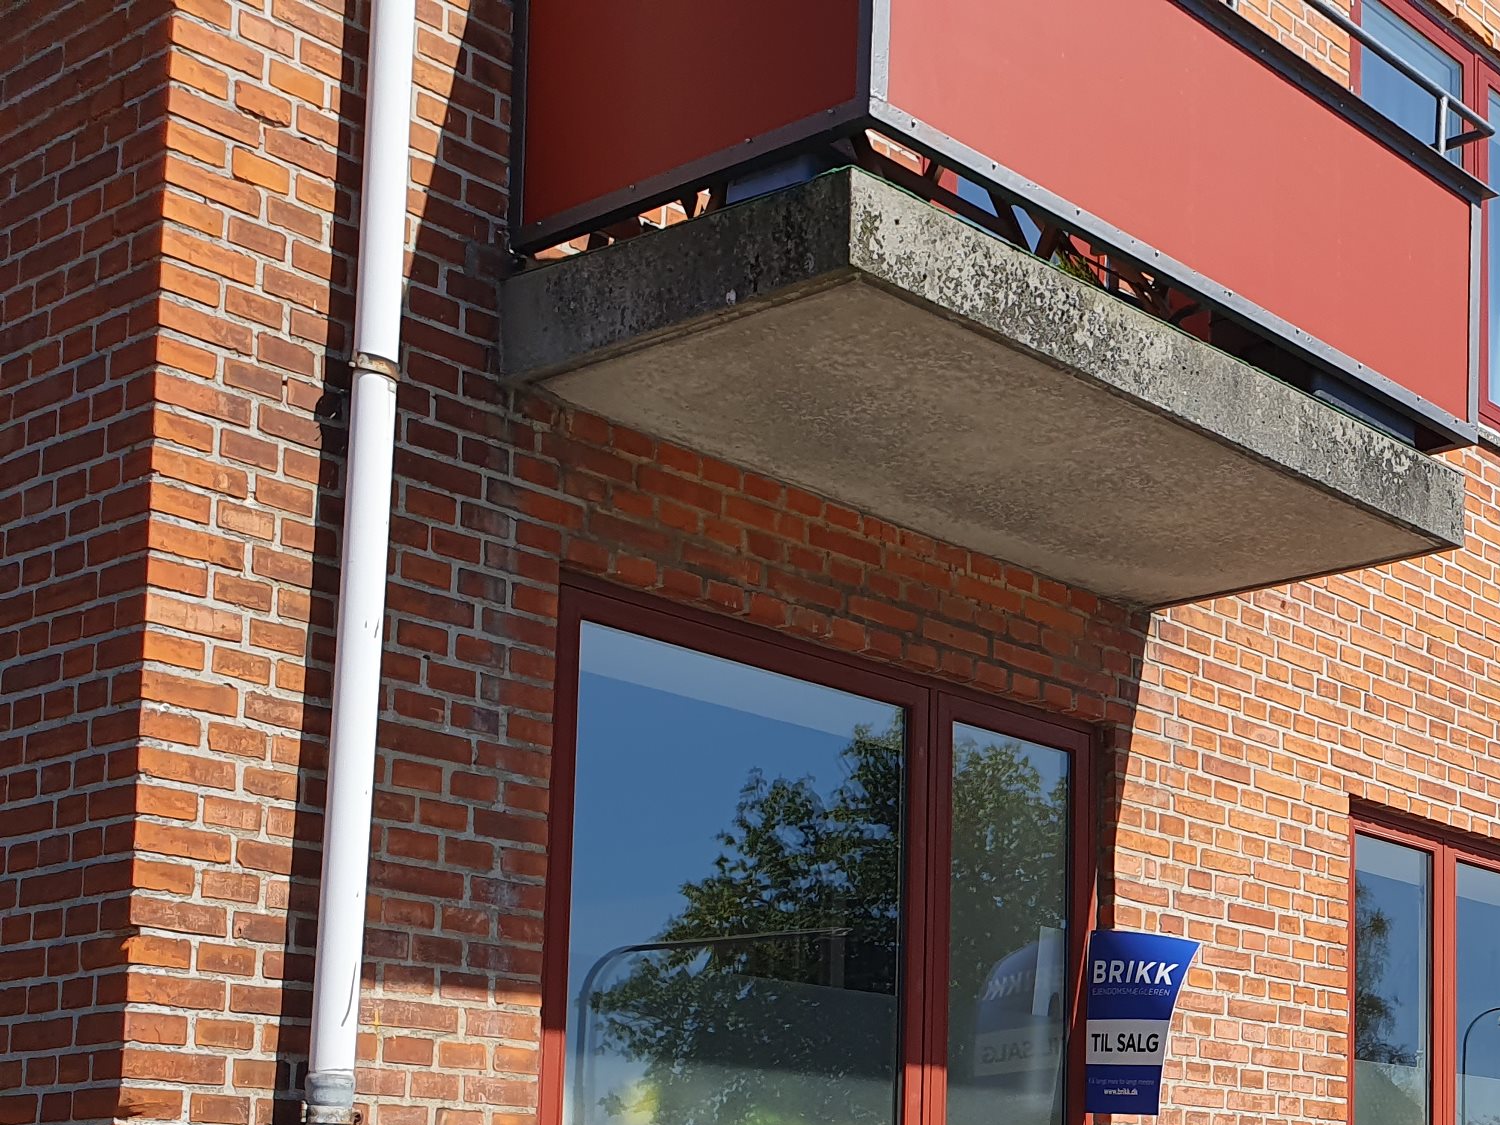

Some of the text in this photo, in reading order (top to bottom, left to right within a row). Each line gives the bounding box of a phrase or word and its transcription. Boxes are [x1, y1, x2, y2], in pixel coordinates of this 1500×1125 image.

[1093, 960, 1179, 985] BRIKK
[1091, 1033, 1159, 1053] TIL SALG
